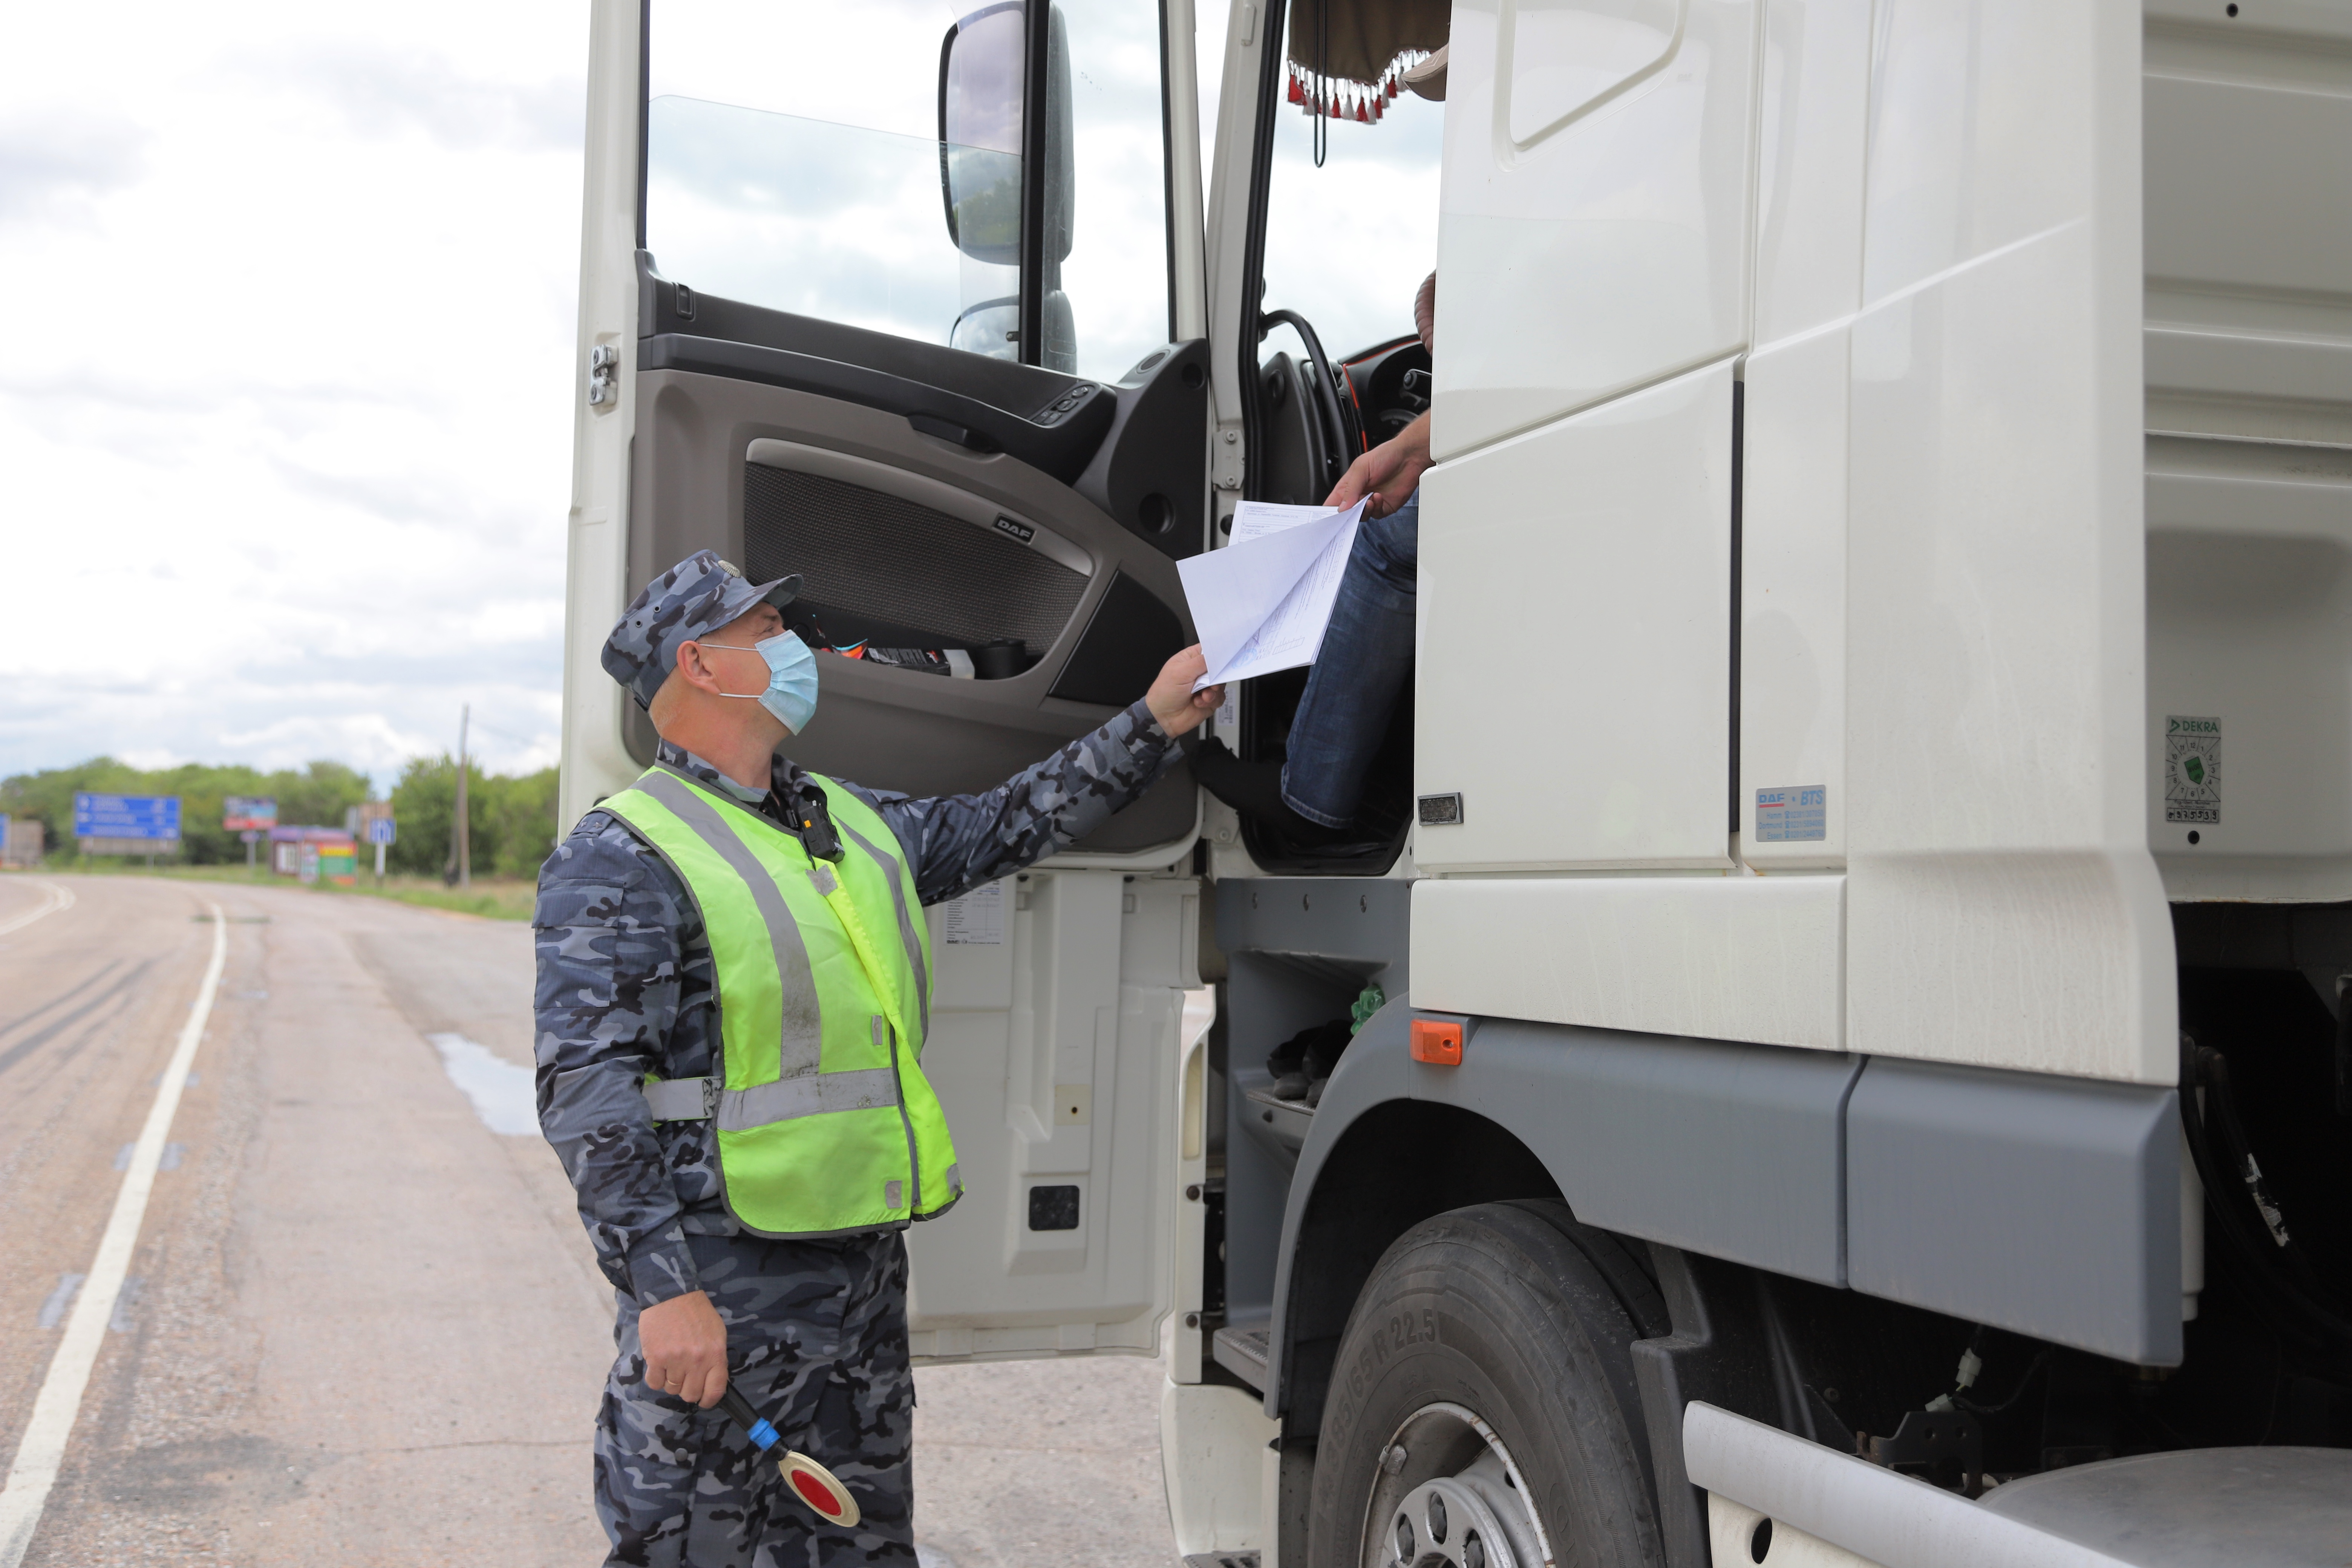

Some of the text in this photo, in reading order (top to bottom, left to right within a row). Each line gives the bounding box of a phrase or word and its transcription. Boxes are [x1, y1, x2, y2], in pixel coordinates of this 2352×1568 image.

[997, 519, 1031, 537] DAF
[2182, 720, 2219, 733] DEKRA
[1758, 789, 1823, 806] DAF BTS
[1759, 821, 1782, 829] Dortmund
[1325, 1347, 1374, 1473] 385/65
[1372, 1329, 1390, 1366] R
[1390, 1308, 1436, 1352] 22.5
